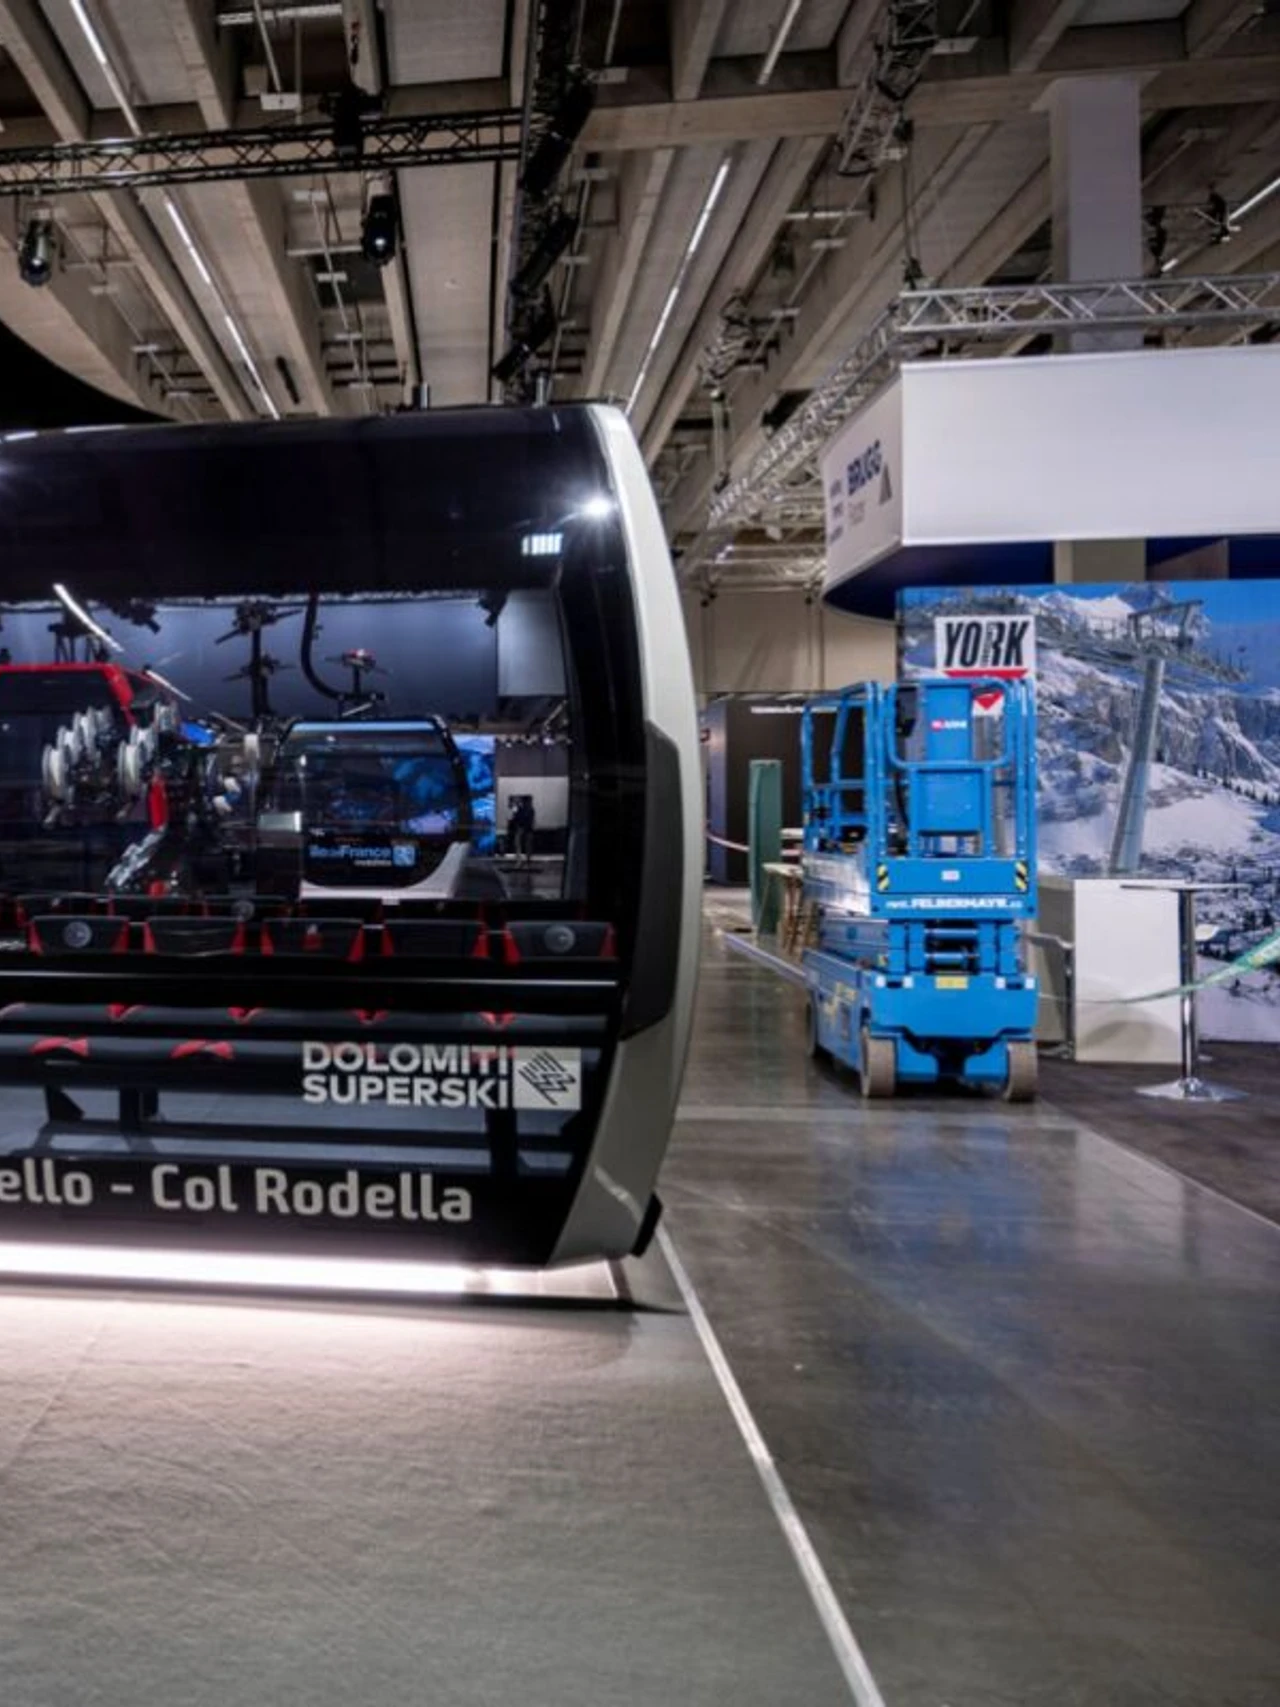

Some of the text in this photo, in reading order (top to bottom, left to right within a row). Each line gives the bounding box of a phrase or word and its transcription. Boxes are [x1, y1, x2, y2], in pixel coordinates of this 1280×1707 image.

[944, 621, 1030, 668] YORK
[302, 1040, 509, 1076] DOLOMITI
[302, 1074, 509, 1109] SUPERSKI
[151, 1164, 238, 1212] Col
[255, 1167, 473, 1222] Rodella
